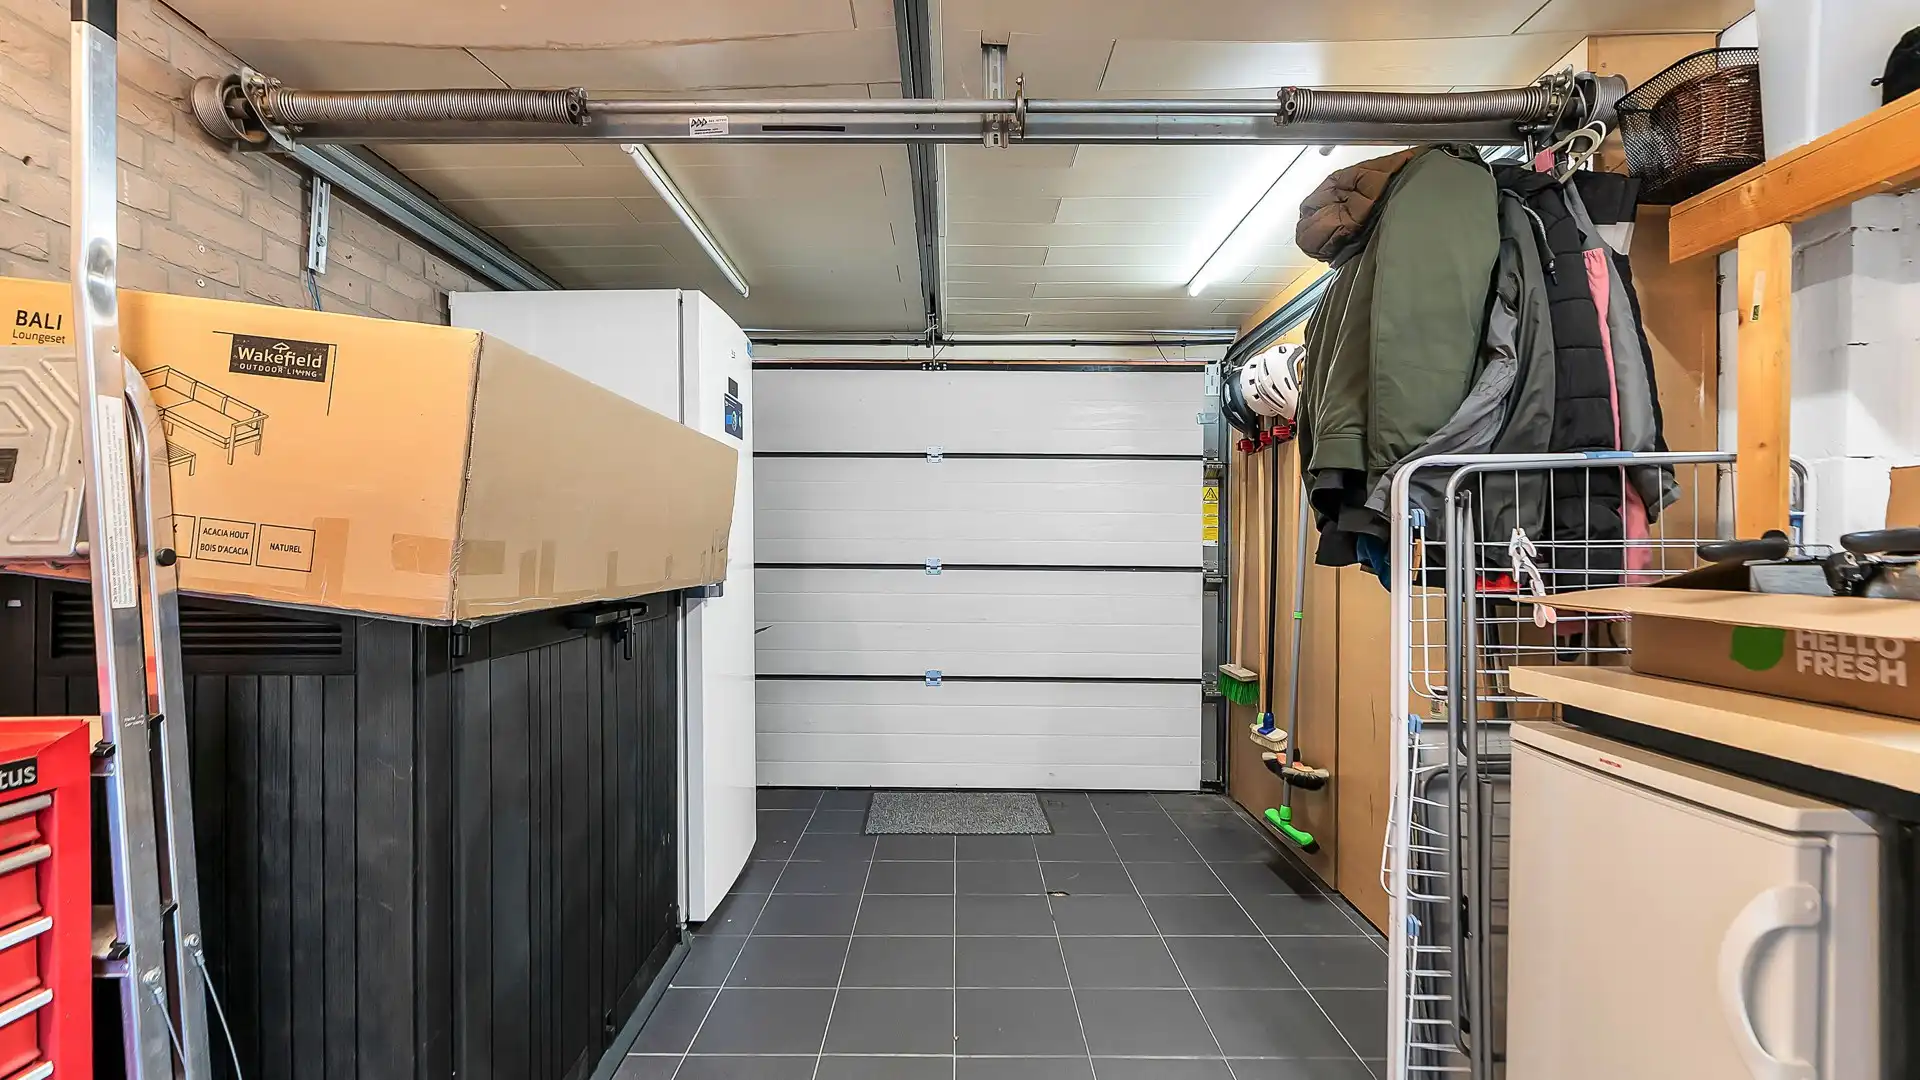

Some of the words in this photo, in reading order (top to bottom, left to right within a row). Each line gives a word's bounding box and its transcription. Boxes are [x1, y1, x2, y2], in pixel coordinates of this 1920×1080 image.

[15, 309, 62, 330] BALI
[12, 329, 66, 344] Loungeset
[238, 346, 323, 368] Wakefield
[240, 362, 283, 373] OUTDOOR
[287, 369, 317, 378] LIVING
[202, 527, 229, 537] ACACIA
[229, 530, 250, 540] HOUT
[200, 543, 217, 552] BOIS
[217, 544, 249, 556] D'ACACIA
[269, 542, 302, 554] NATUREL
[1796, 630, 1906, 660] HELLO
[1796, 649, 1908, 687] FRESH
